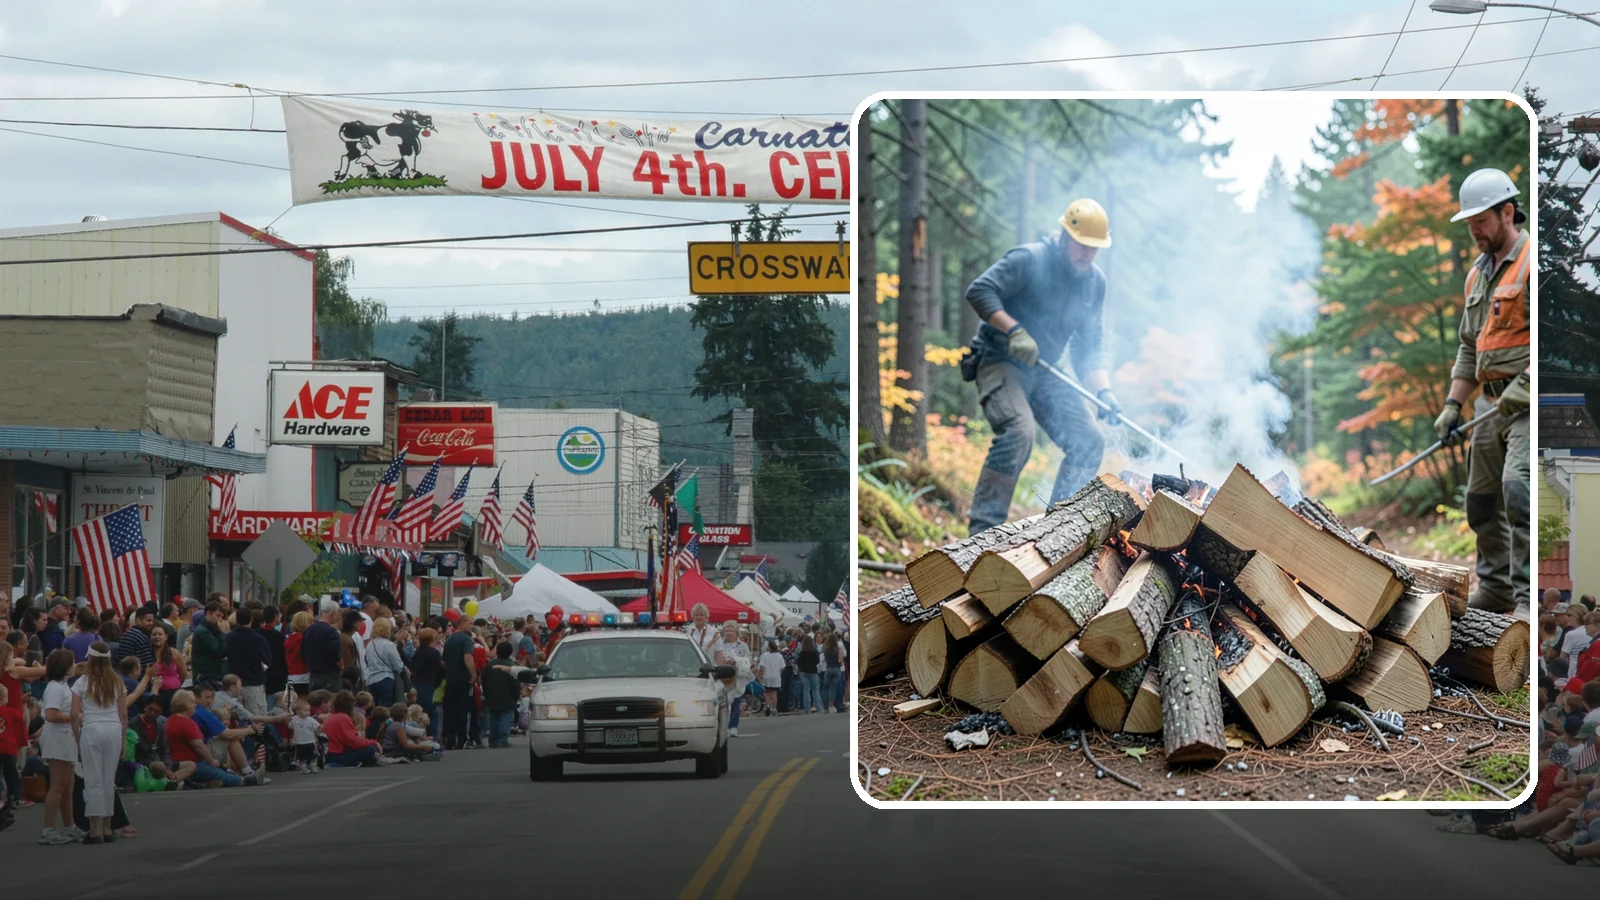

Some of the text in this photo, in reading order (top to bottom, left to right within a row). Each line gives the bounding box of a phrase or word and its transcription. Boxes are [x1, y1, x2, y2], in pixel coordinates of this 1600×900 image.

[695, 121, 850, 150] Carnat
[481, 141, 604, 192] JULY
[632, 149, 746, 198] 4th.
[697, 254, 850, 280] CROSSWA
[282, 380, 373, 420] ACE
[406, 409, 485, 422] CEDAR LOG
[283, 421, 371, 436] Hardware
[416, 428, 476, 447] Coca-Cola
[353, 466, 386, 480] Simpl
[95, 484, 125, 495] Vincent
[126, 486, 136, 495] de
[137, 486, 155, 495] Paul
[213, 516, 331, 535] HARDARE
[688, 526, 741, 535] CRNATION
[699, 535, 730, 544] GLASS
